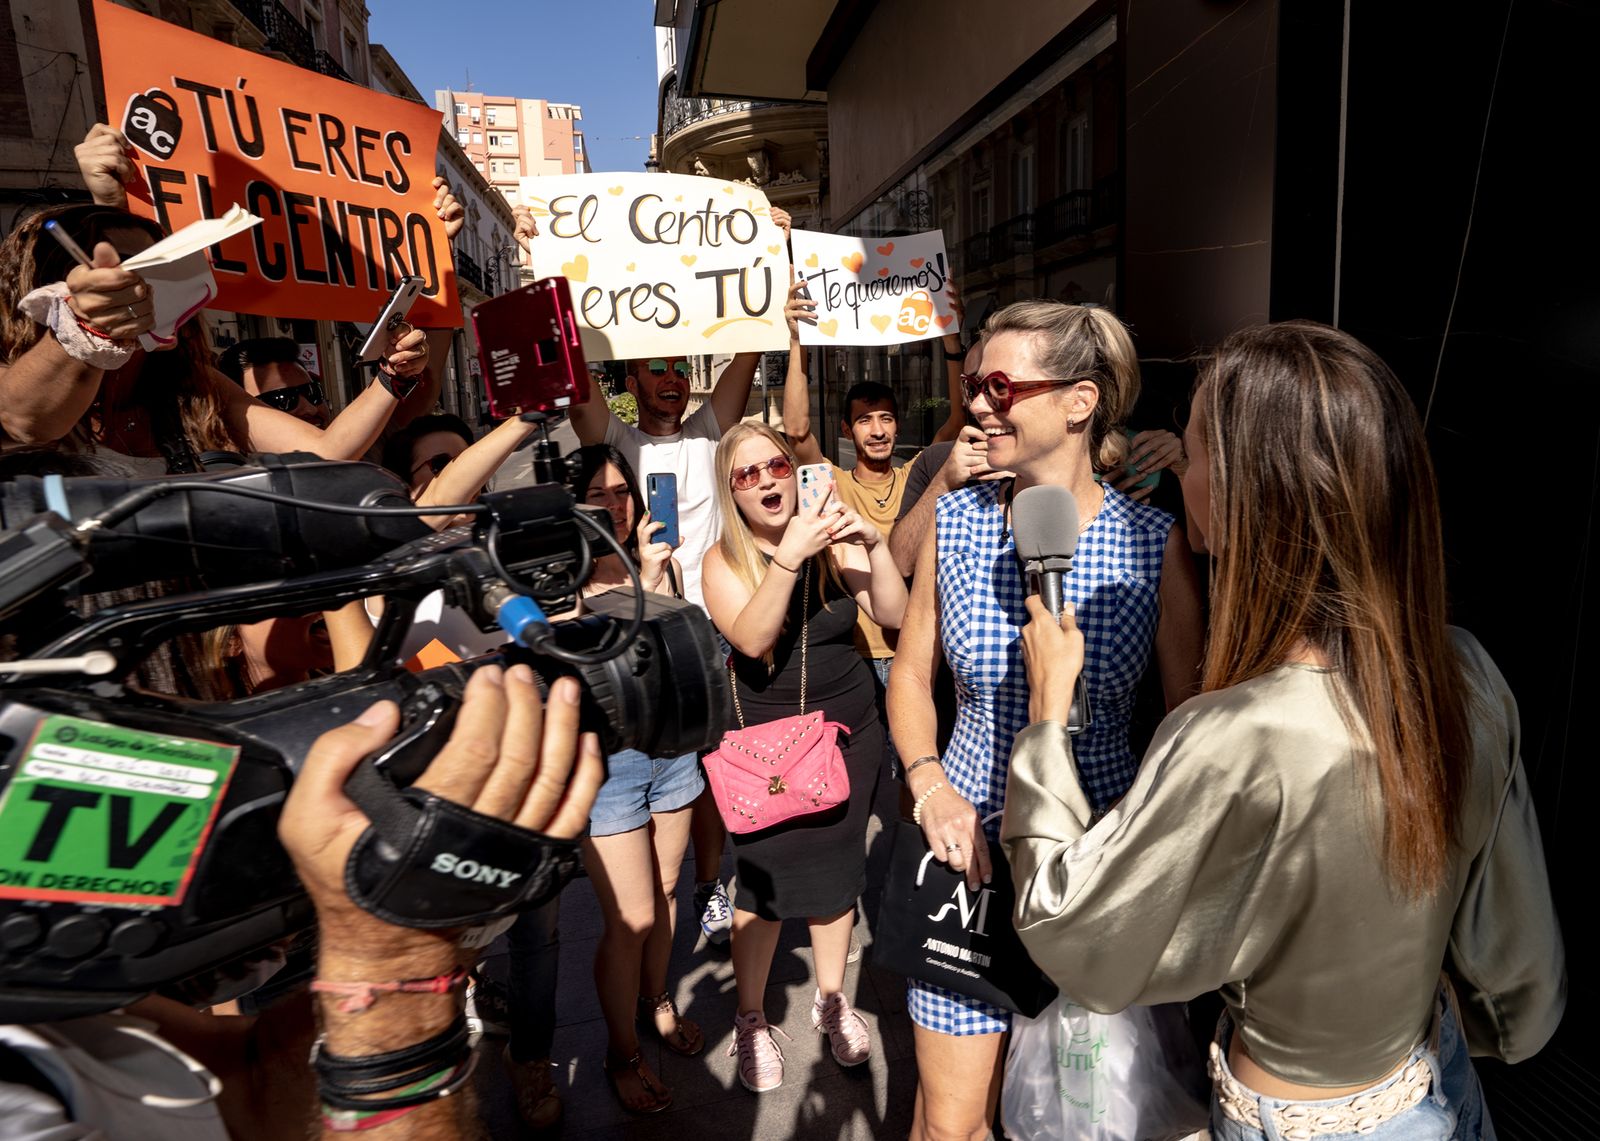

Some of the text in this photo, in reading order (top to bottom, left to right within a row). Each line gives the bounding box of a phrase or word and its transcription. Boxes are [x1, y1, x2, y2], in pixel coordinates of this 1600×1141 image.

[130, 106, 175, 153] ac
[171, 75, 411, 195] TÚ ERES
[245, 180, 440, 298] CENTRO
[549, 193, 758, 247] El Centro
[581, 256, 772, 330] eres TÚ
[844, 252, 946, 330] queremos!
[22, 783, 191, 870] TV
[40, 873, 174, 896] DERECHOS
[430, 852, 522, 888] SONY
[922, 938, 960, 958] ANTONIO
